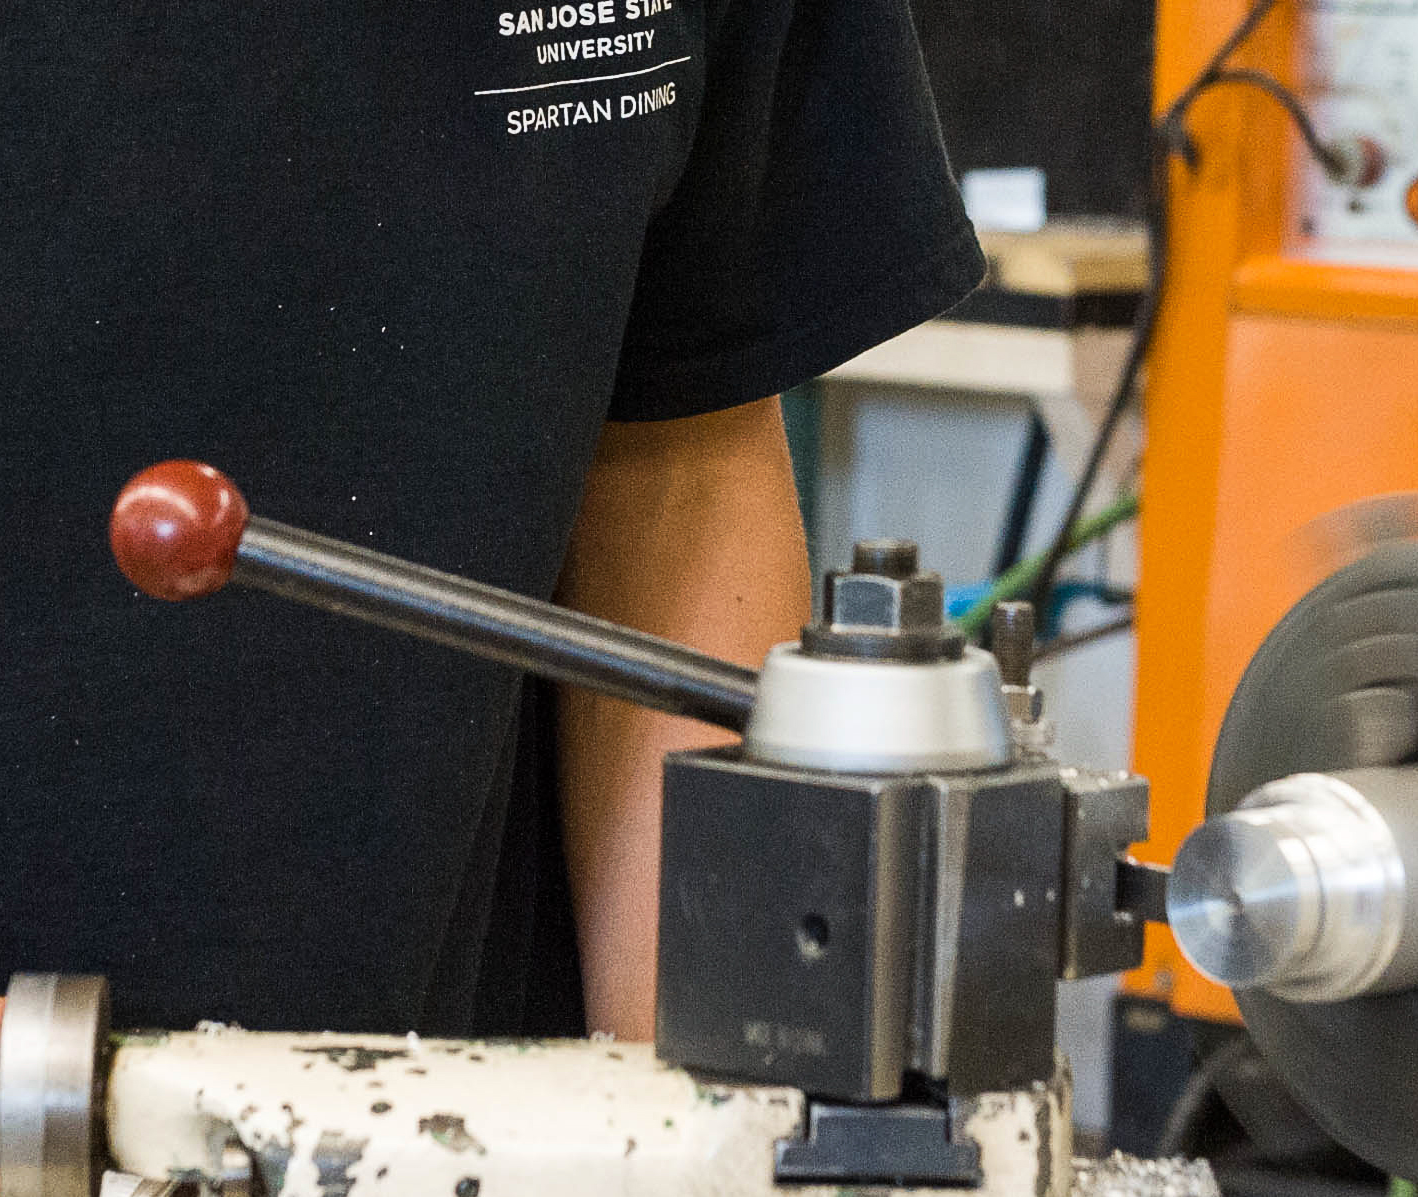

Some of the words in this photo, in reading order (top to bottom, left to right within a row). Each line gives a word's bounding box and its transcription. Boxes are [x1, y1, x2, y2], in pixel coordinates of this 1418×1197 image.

[499, 8, 544, 37] SAN
[536, 29, 655, 65] UNIVERSITY
[507, 98, 612, 135] SPARTAN
[620, 82, 676, 119] DINING
